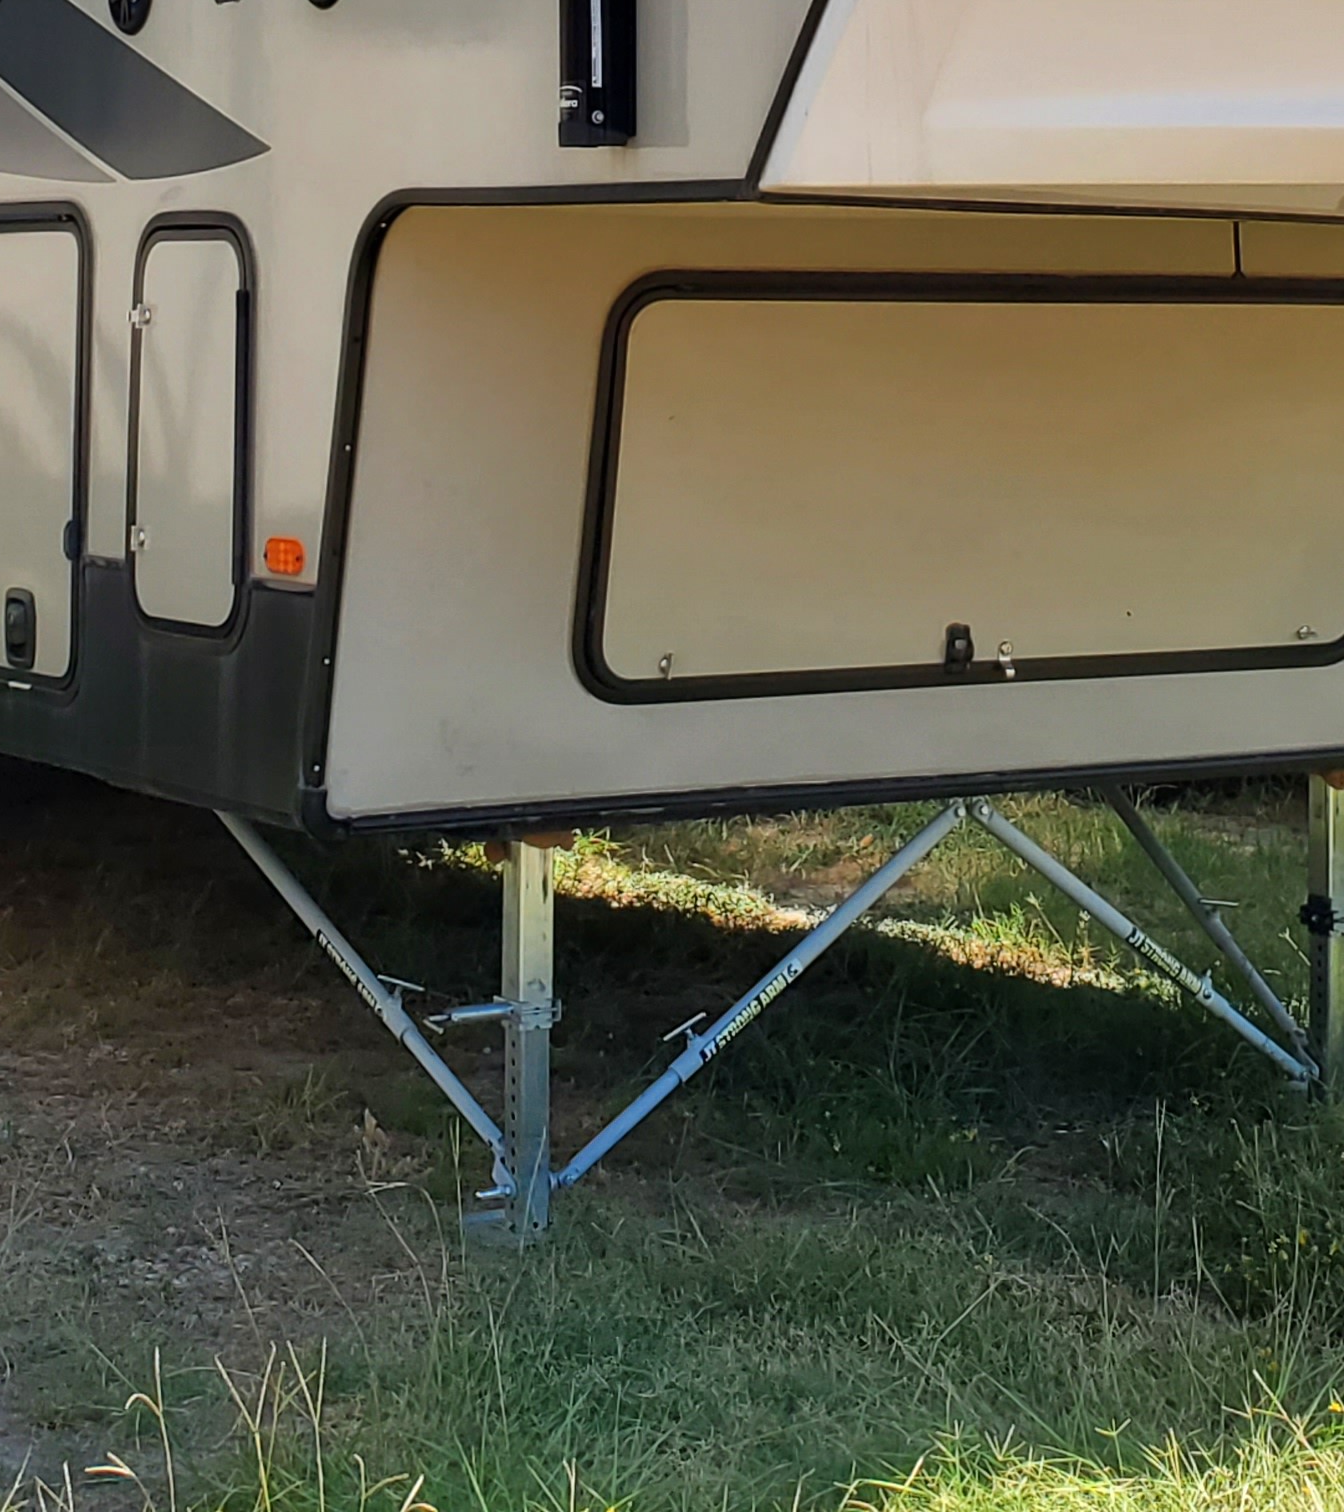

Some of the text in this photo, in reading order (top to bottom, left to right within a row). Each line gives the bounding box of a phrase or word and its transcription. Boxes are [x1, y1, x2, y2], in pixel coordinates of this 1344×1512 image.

[1140, 937, 1181, 977] STRONG
[715, 999, 762, 1049] STRONG
[759, 973, 787, 1009] ARM
